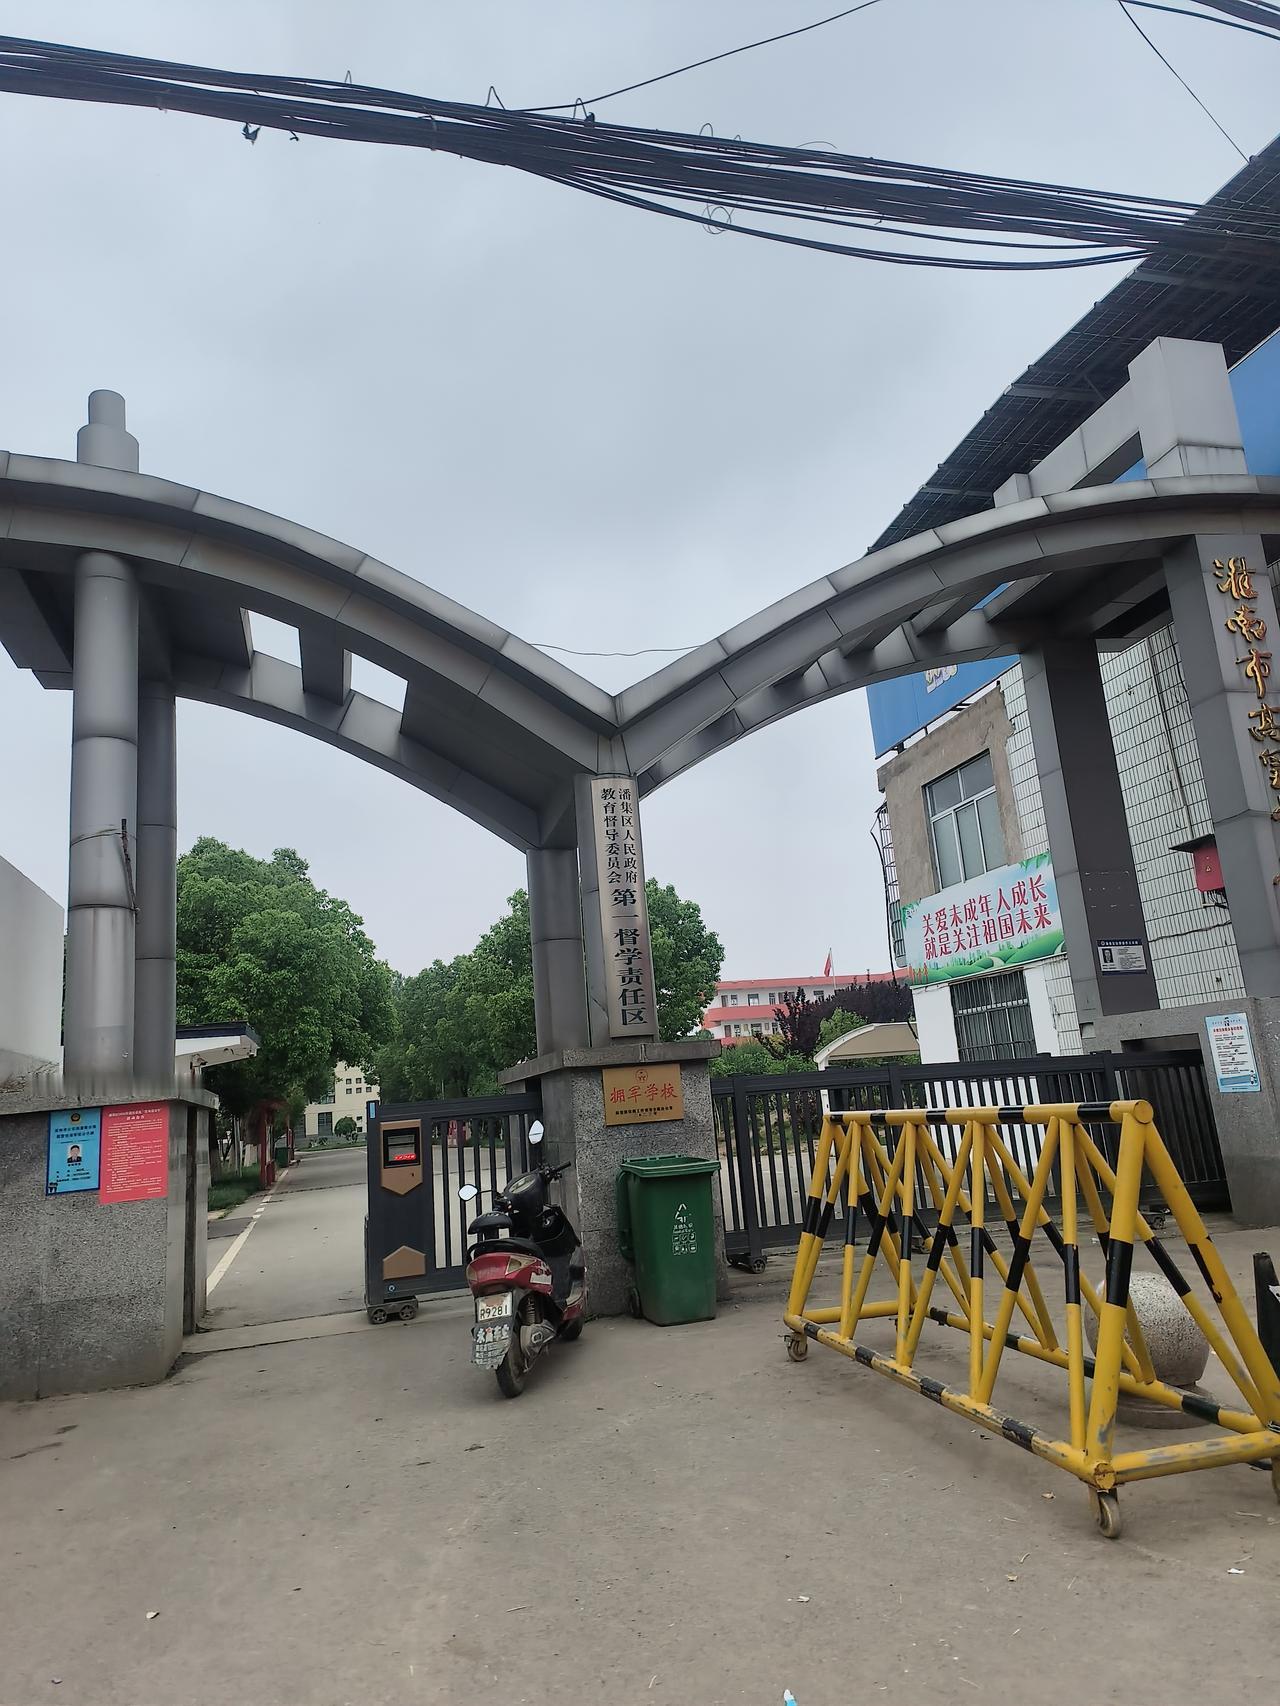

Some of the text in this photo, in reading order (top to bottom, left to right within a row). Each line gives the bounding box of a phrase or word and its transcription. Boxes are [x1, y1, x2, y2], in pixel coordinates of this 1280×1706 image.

[600, 788, 622, 884] 教育督导委员会
[618, 788, 638, 884] 潘集区人民政府
[922, 874, 1047, 937] 关爱未成年人成长
[924, 903, 1052, 960] 就是关注祖国未来
[611, 888, 648, 1026] 第一督学责任区
[610, 1082, 678, 1103] 拥军学校
